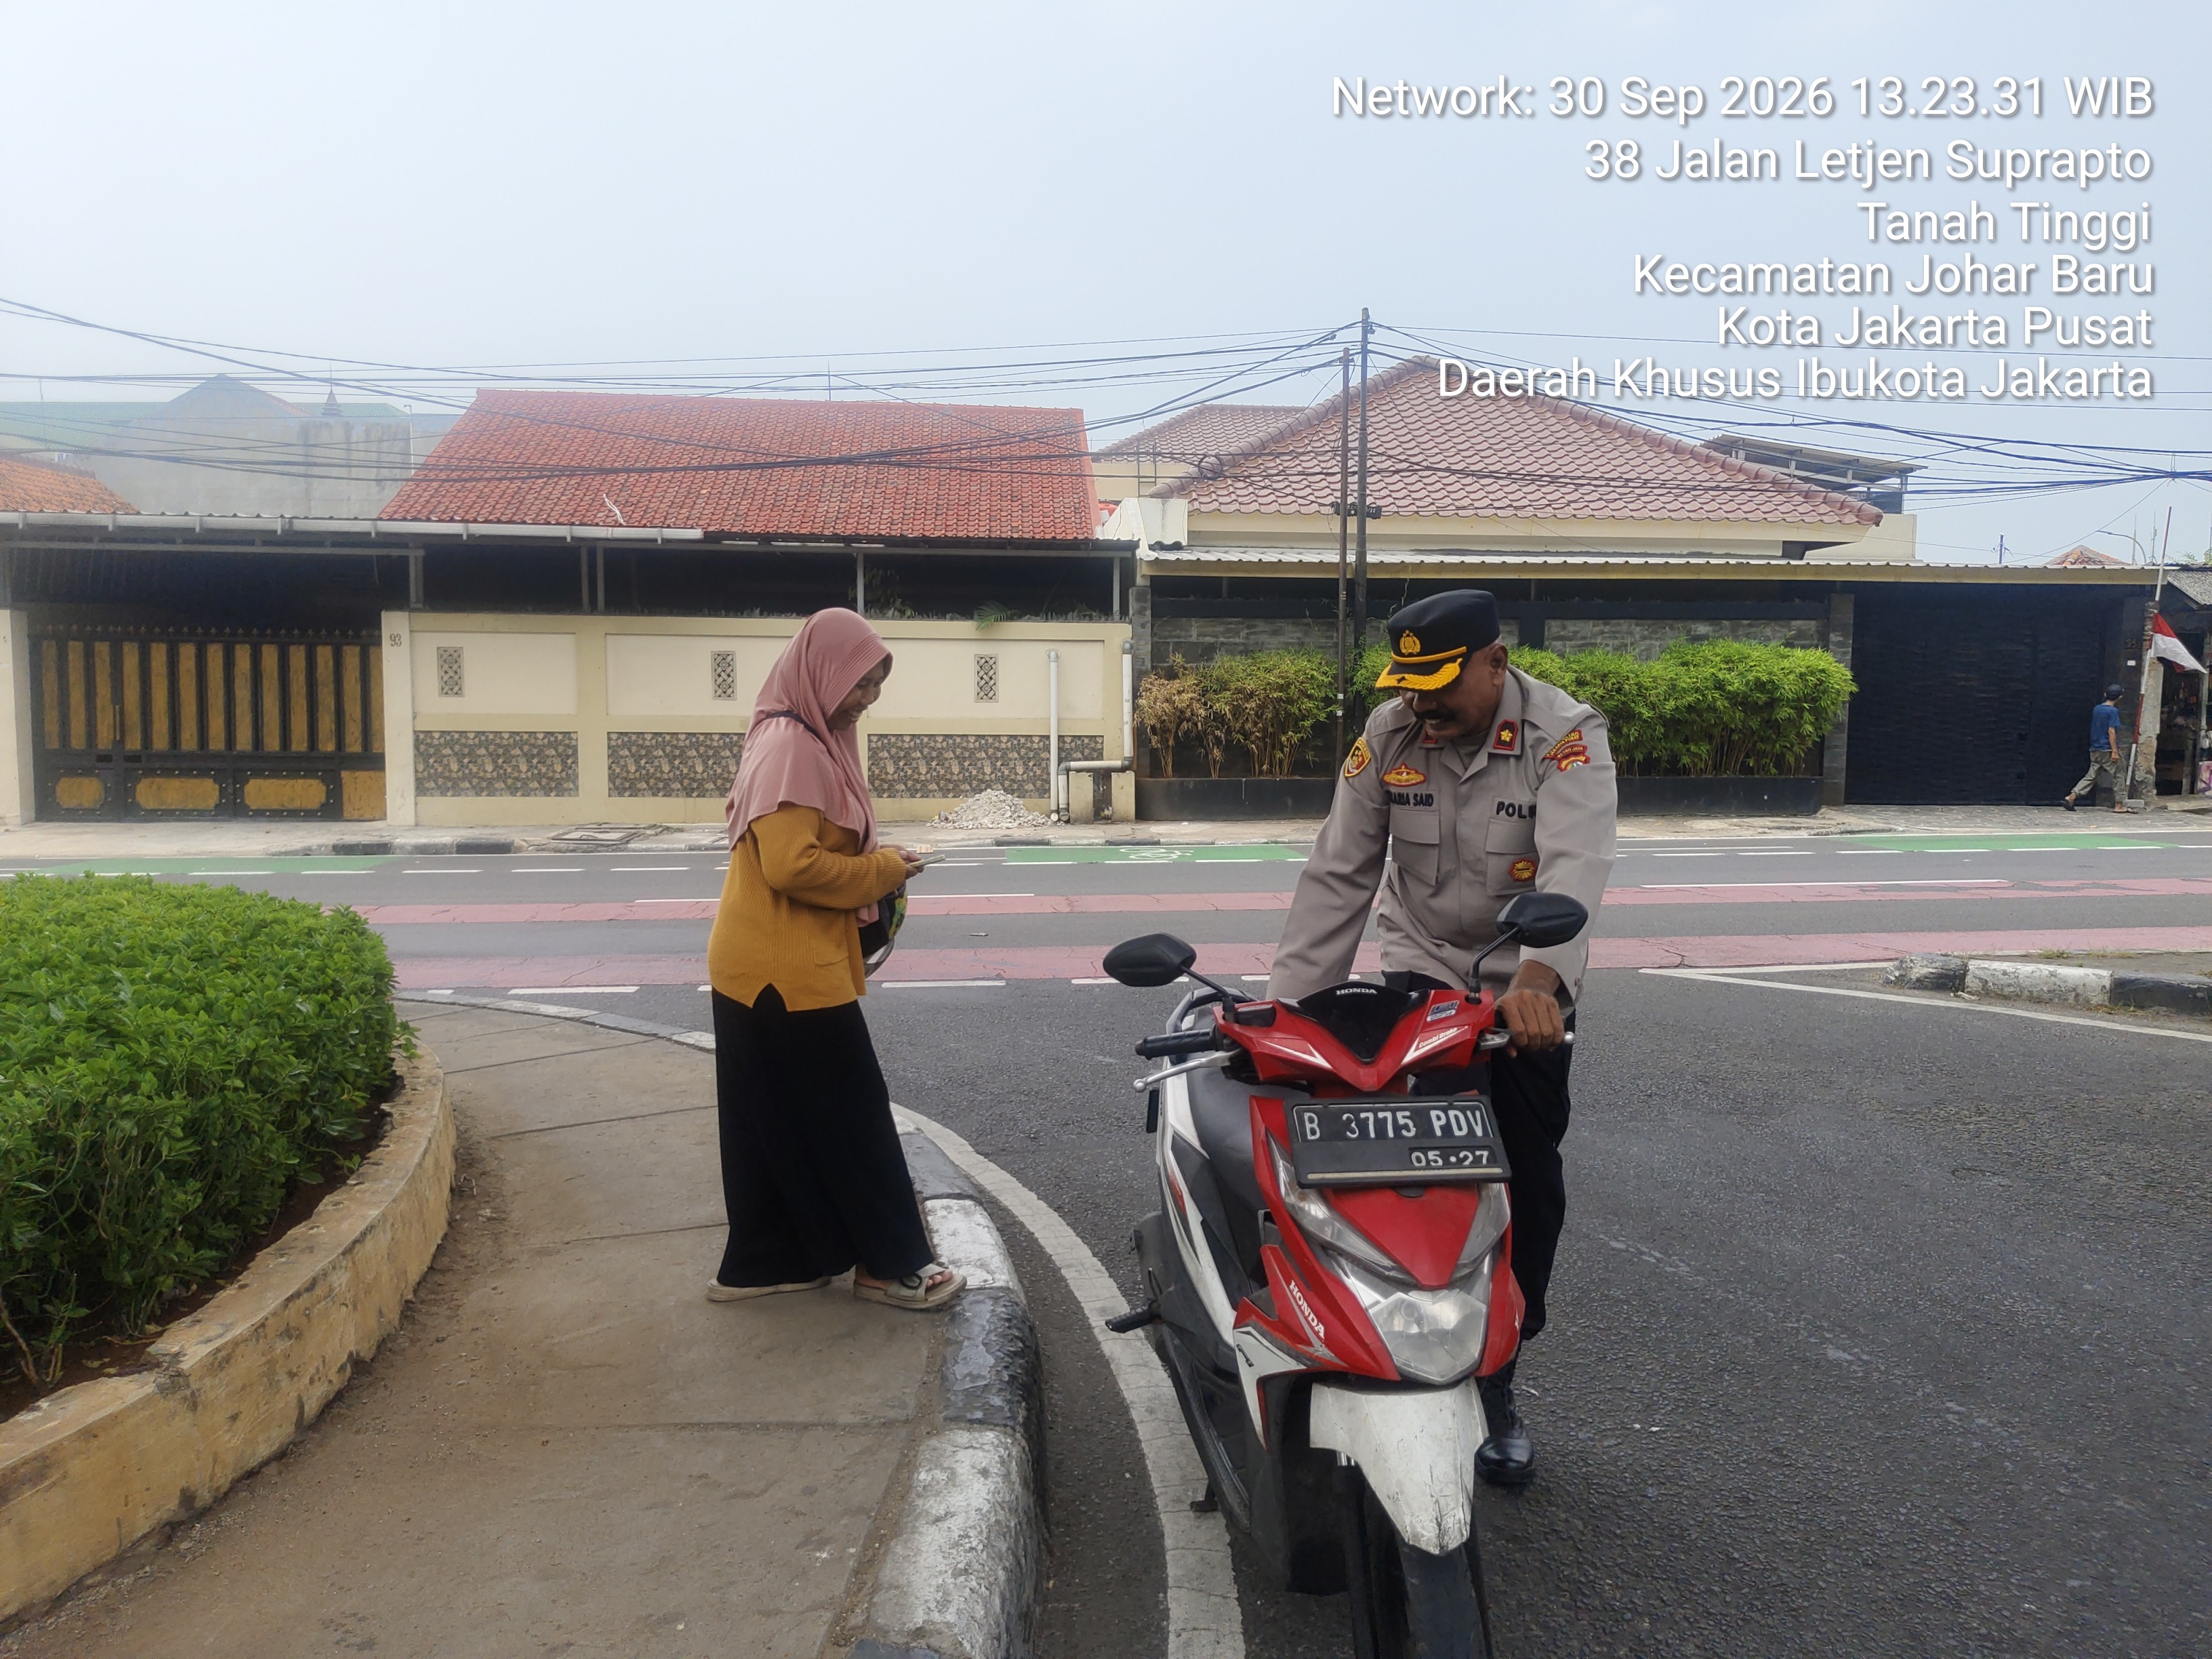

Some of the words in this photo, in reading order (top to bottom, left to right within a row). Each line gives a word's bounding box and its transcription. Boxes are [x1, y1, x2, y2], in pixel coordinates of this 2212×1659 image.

[390, 633, 402, 647] 93
[1413, 793, 1434, 807] SAID
[1336, 987, 1378, 996] HONDA
[1303, 1111, 1321, 1140] B
[1342, 1111, 1416, 1139] 3775
[1429, 1109, 1483, 1137] PDV
[1289, 1279, 1326, 1339] HONDA
